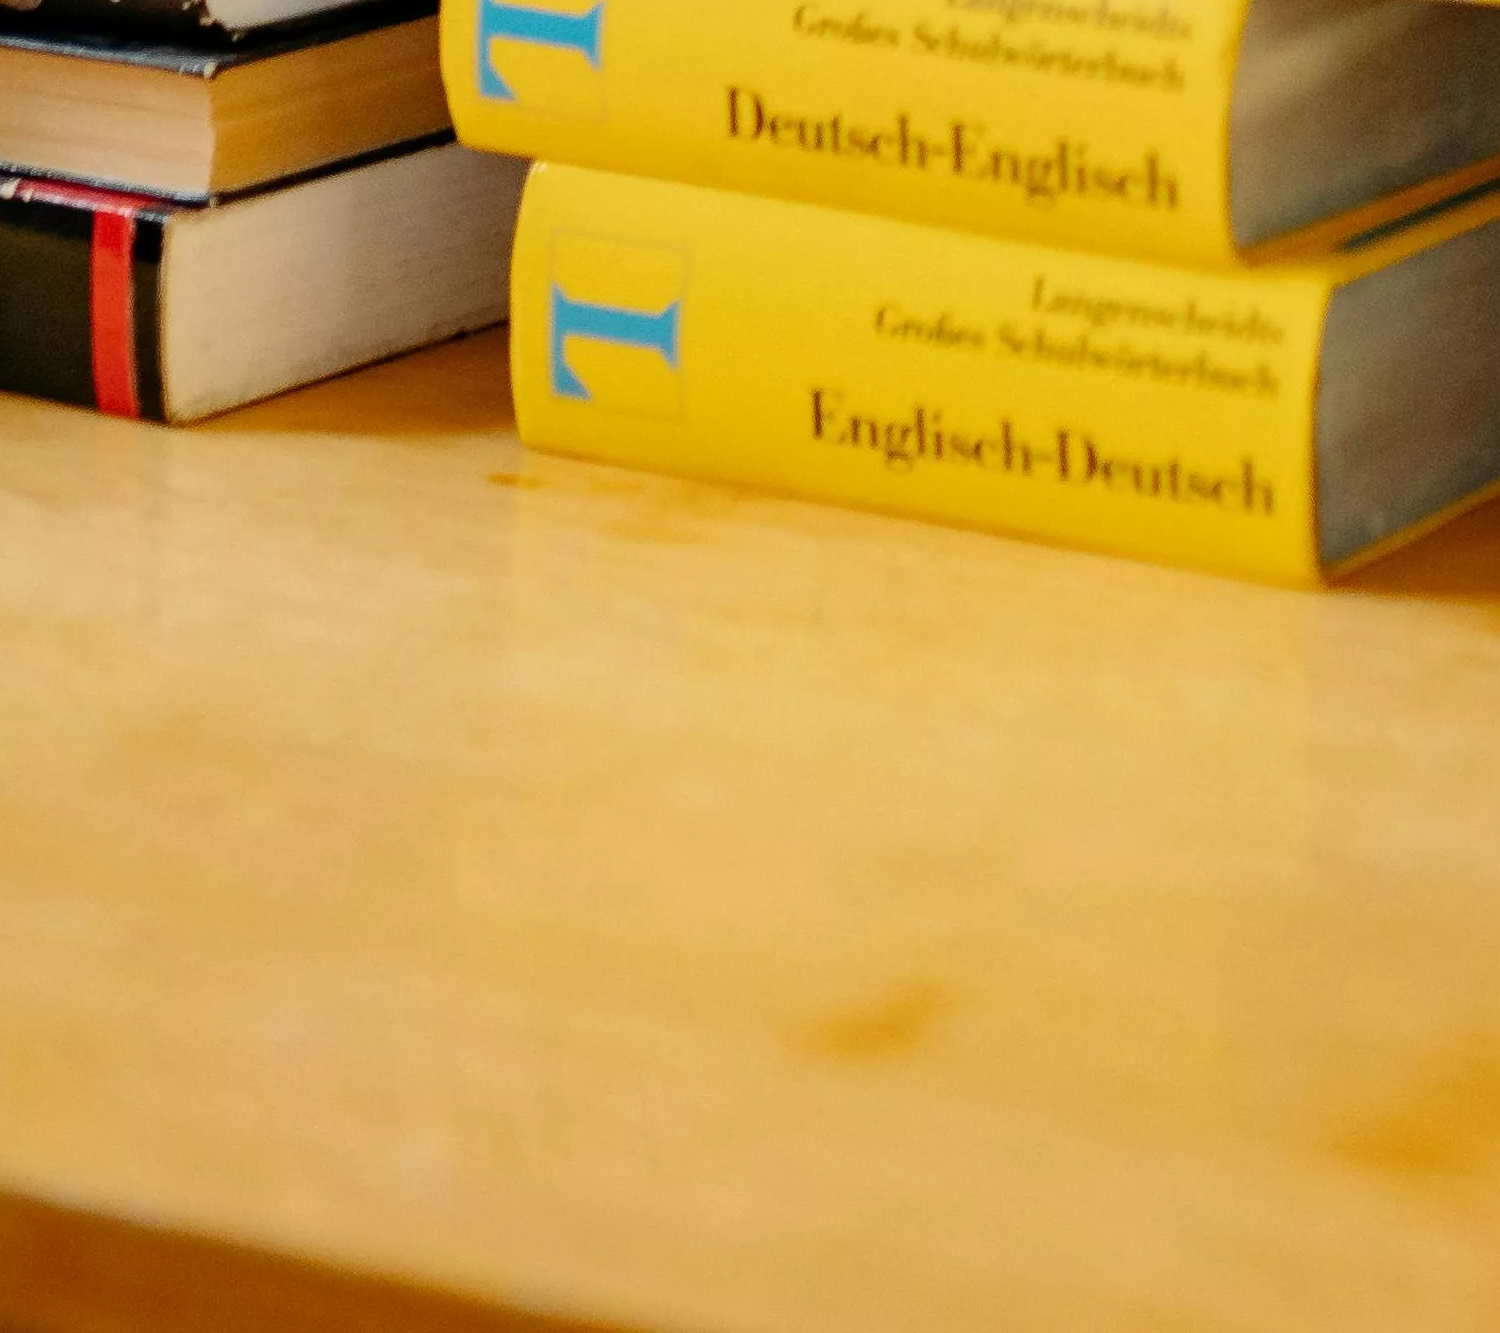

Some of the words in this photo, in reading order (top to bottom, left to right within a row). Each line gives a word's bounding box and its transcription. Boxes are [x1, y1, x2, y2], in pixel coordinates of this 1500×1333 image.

[912, 20, 1185, 92] Schulwörterbuch
[726, 84, 1180, 212] Deutsch-Englisch
[995, 323, 1281, 397] Schulwörterbuch
[808, 386, 1276, 517] Englisch-Deutsch
